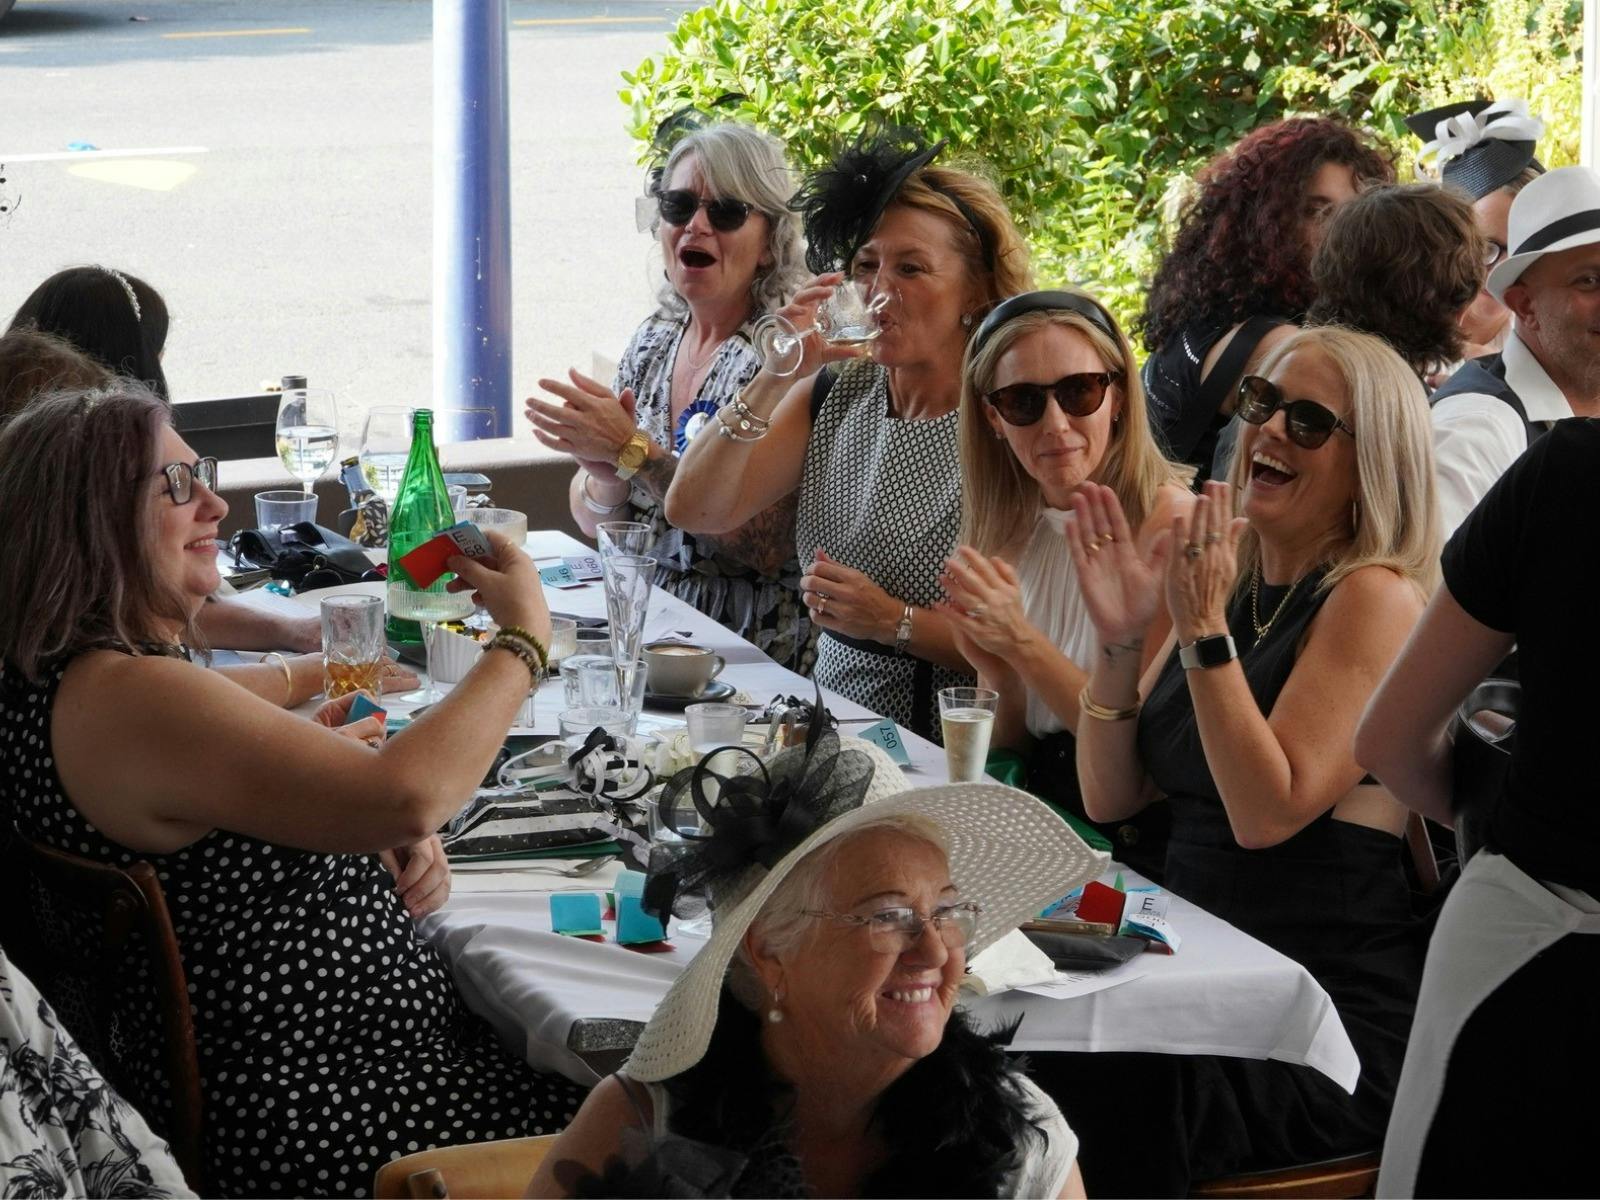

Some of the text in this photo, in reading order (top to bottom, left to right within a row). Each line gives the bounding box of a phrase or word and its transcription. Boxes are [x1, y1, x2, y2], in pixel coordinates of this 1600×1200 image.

[452, 530, 467, 543] E
[464, 544, 486, 557] 58
[584, 557, 602, 574] 060
[879, 726, 898, 749] 057
[1141, 897, 1156, 911] E
